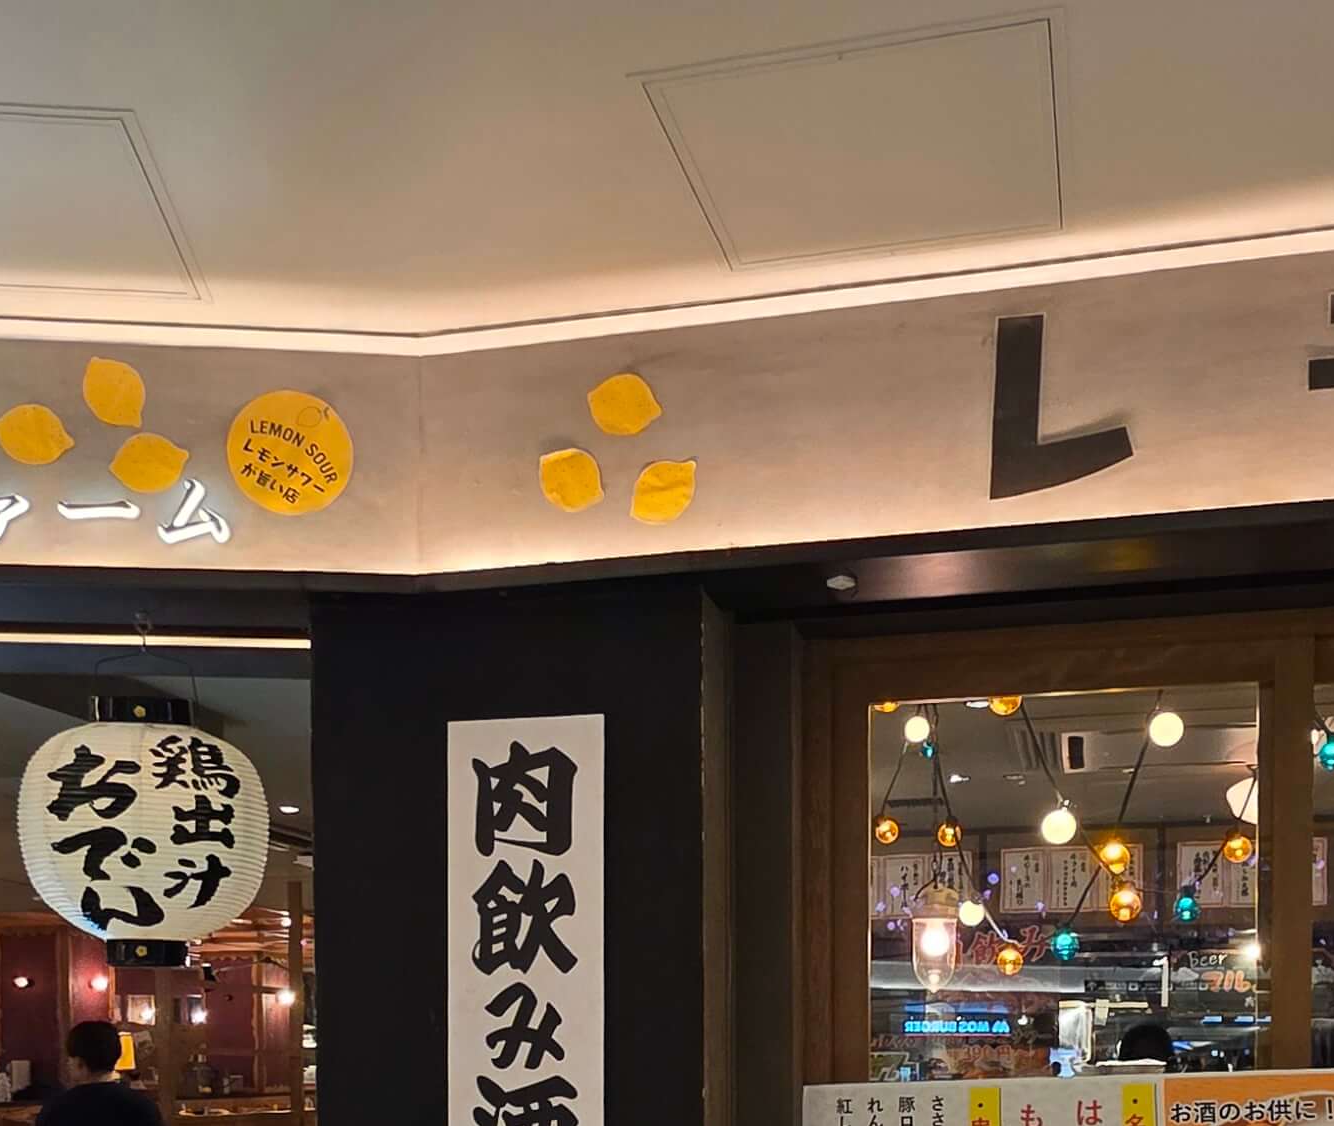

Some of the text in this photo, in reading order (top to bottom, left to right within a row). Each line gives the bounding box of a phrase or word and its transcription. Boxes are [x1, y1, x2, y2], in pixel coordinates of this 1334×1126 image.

[240, 462, 301, 504] が旨い店
[242, 438, 326, 494] レモンサワー
[250, 418, 339, 484] LEMON SOUR
[45, 744, 165, 931] おでん
[149, 735, 241, 910] 鶏出汁
